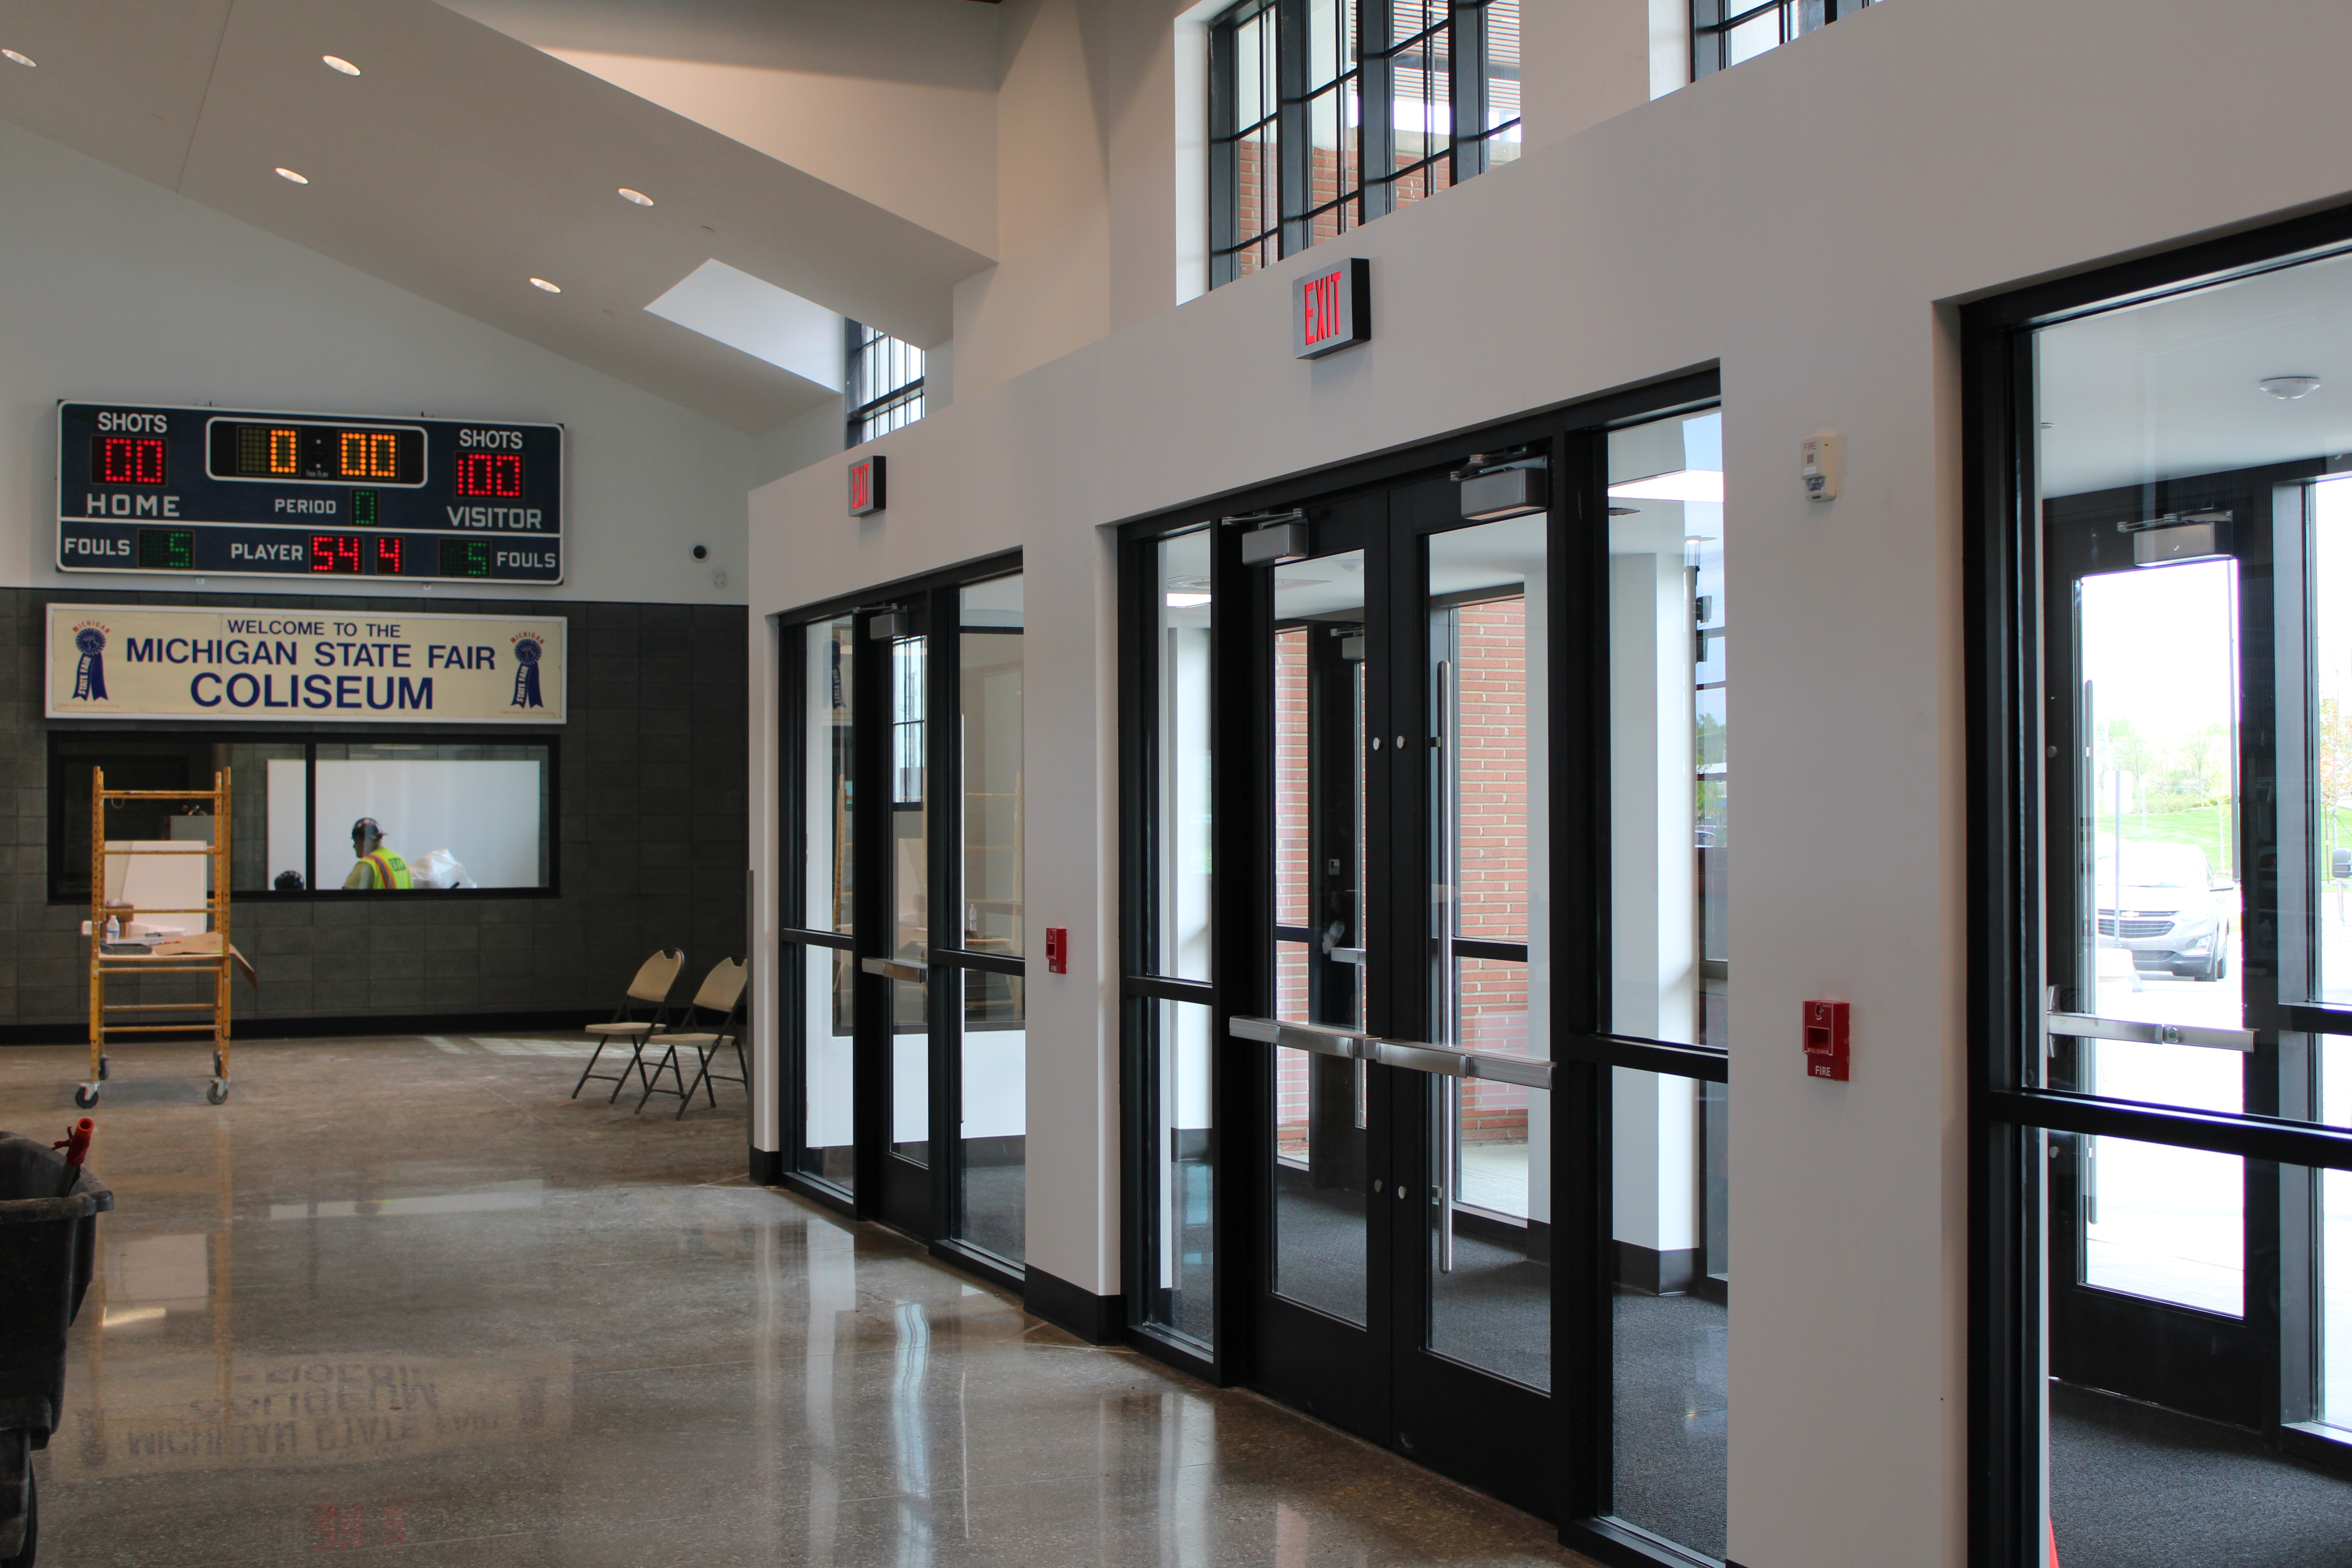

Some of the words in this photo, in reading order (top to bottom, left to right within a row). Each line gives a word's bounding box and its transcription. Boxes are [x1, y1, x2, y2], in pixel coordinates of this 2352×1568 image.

[1305, 270, 1341, 345] EXIT
[98, 412, 167, 433] SHOTS
[459, 429, 523, 449] SHOTS
[1804, 442, 1817, 450] FIRE
[105, 438, 163, 483] 00
[853, 463, 869, 509] EXIT
[87, 493, 180, 517] HOME
[275, 499, 336, 514] PERIOD
[447, 506, 542, 529] VISITOR
[64, 537, 131, 555] FOULS
[231, 543, 303, 561] PLAYER
[497, 552, 556, 568] FOULS
[73, 620, 111, 634] MICHIGAN
[227, 619, 325, 635] WELCOME
[333, 622, 358, 636] TO
[366, 623, 401, 638] THE
[510, 631, 545, 644] MICHIGAN
[126, 638, 297, 665] MICHIGAN
[314, 641, 412, 668] STATE
[428, 645, 495, 670] FAIR
[80, 656, 92, 673] FAIR
[518, 665, 529, 681] FAIR
[78, 674, 88, 695] STATE
[191, 672, 433, 710] COLISEUM
[516, 683, 525, 702] STATE
[1815, 1065, 1831, 1076] FIRE
